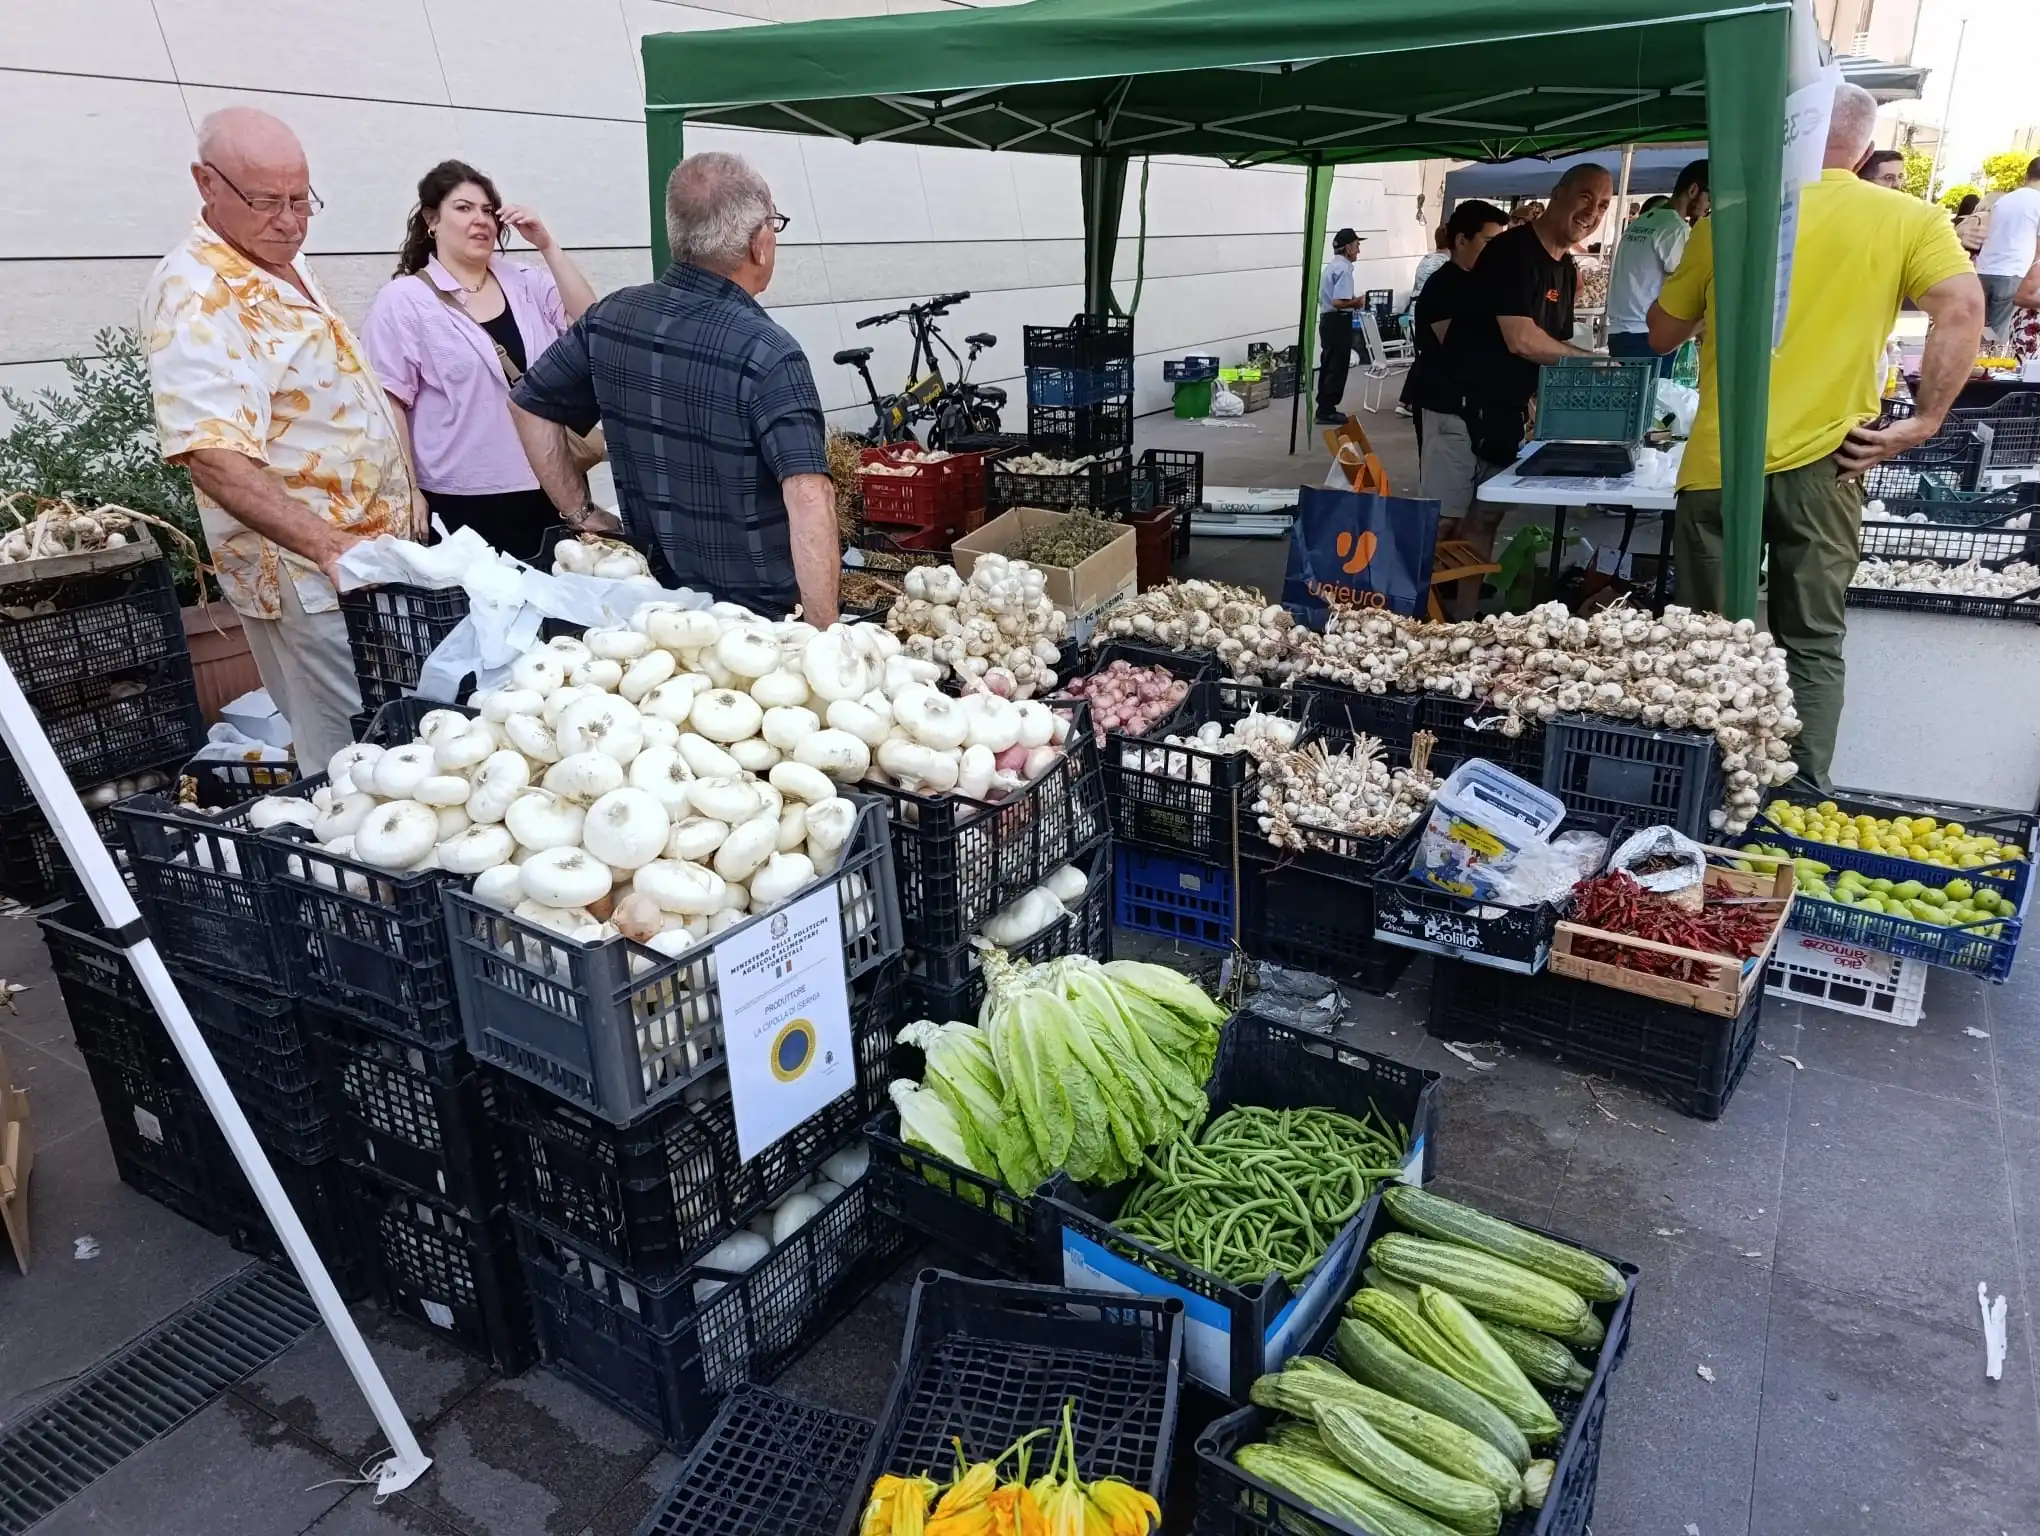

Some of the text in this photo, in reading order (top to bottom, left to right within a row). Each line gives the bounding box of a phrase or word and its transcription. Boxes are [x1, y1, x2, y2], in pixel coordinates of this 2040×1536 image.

[1308, 580, 1387, 609] unieuro
[730, 916, 829, 975] MINISTERO DELLE POLITICHE
[1424, 925, 1477, 948] Paolillo
[742, 929, 820, 977] AGRICOLE ALIMENTARI
[766, 945, 804, 970] FORESTALI
[764, 984, 807, 1015] PRODUTTORE
[753, 1028, 762, 1039] LA
[762, 1011, 789, 1032] CIPOLLA
